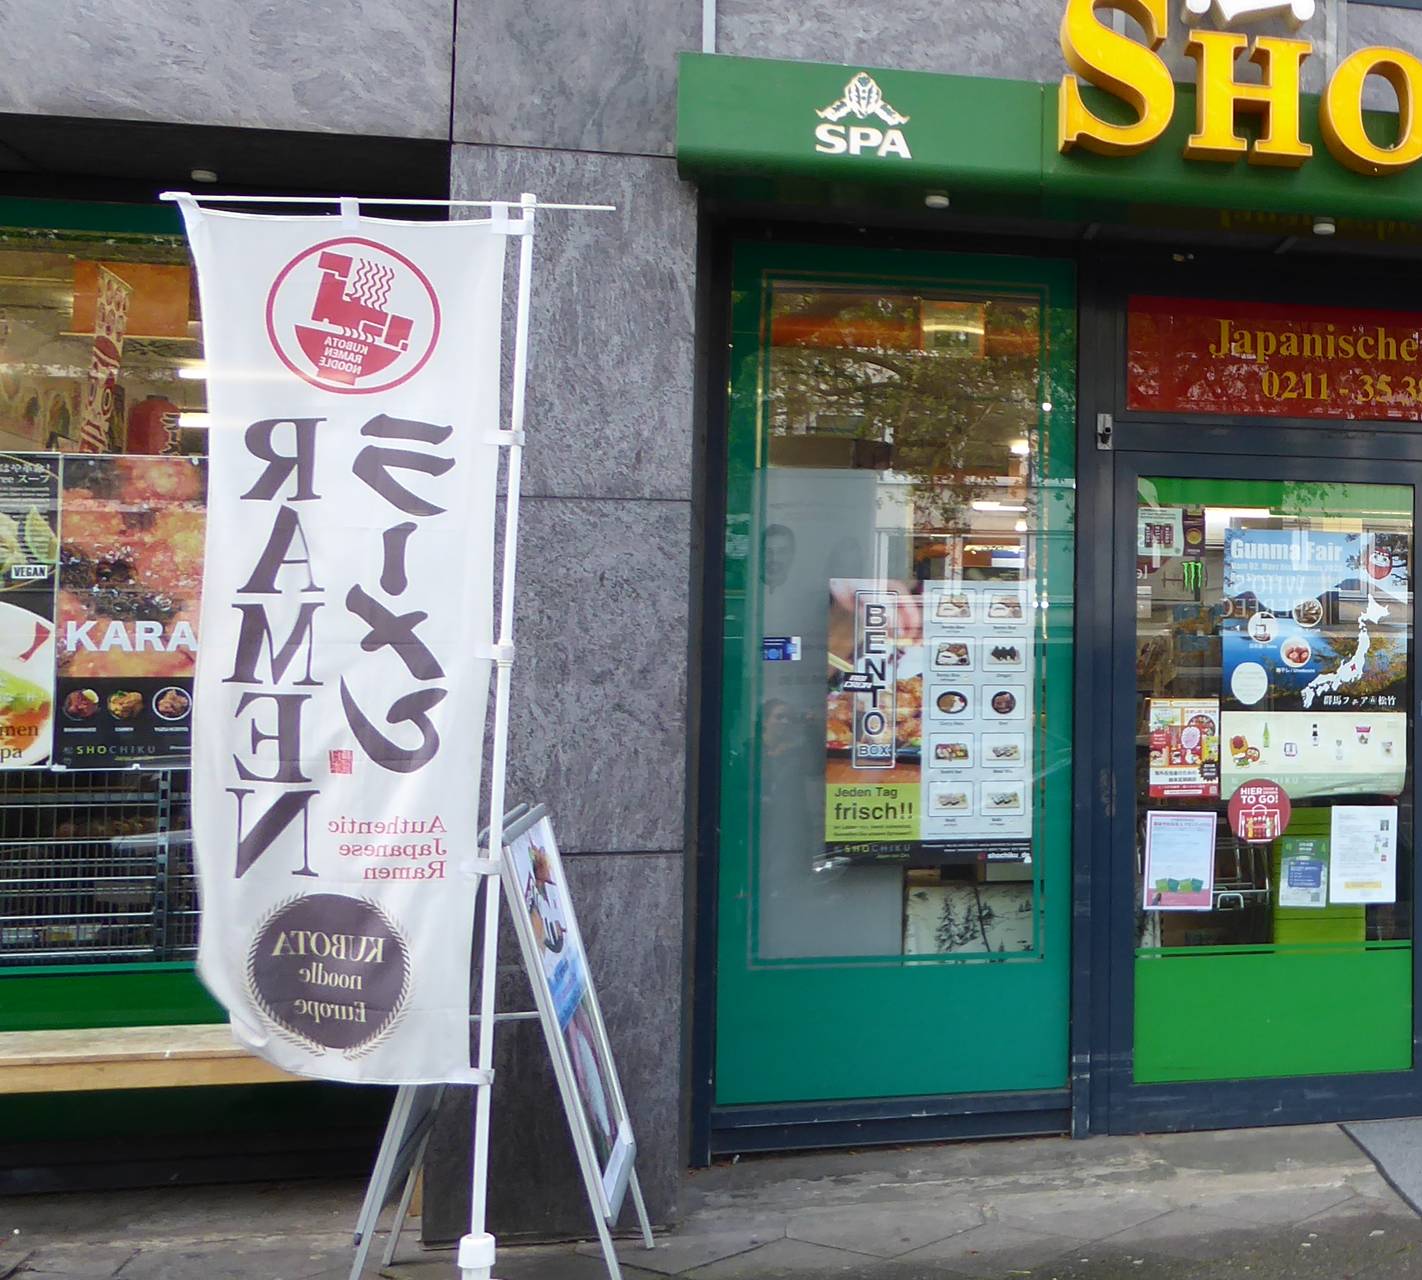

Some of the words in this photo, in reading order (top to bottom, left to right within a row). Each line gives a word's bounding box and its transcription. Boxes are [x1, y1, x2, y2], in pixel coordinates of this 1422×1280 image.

[815, 123, 912, 159] SPA
[1209, 319, 1418, 364] Japanische
[1262, 370, 1329, 400] 0211
[1357, 374, 1393, 402] 35
[1230, 538, 1300, 560] Gunma
[1307, 541, 1343, 561] Fair
[13, 567, 46, 578] VEGAN
[863, 603, 888, 737] BENTO
[76, 745, 157, 755] SHOCHIKU
[857, 743, 892, 757] BOX
[834, 786, 872, 798] Jeden
[875, 787, 898, 799] Tag
[1240, 787, 1263, 795] HIER
[1240, 795, 1256, 804] TO
[1258, 795, 1279, 804] GO!
[834, 803, 913, 820] frisch!!
